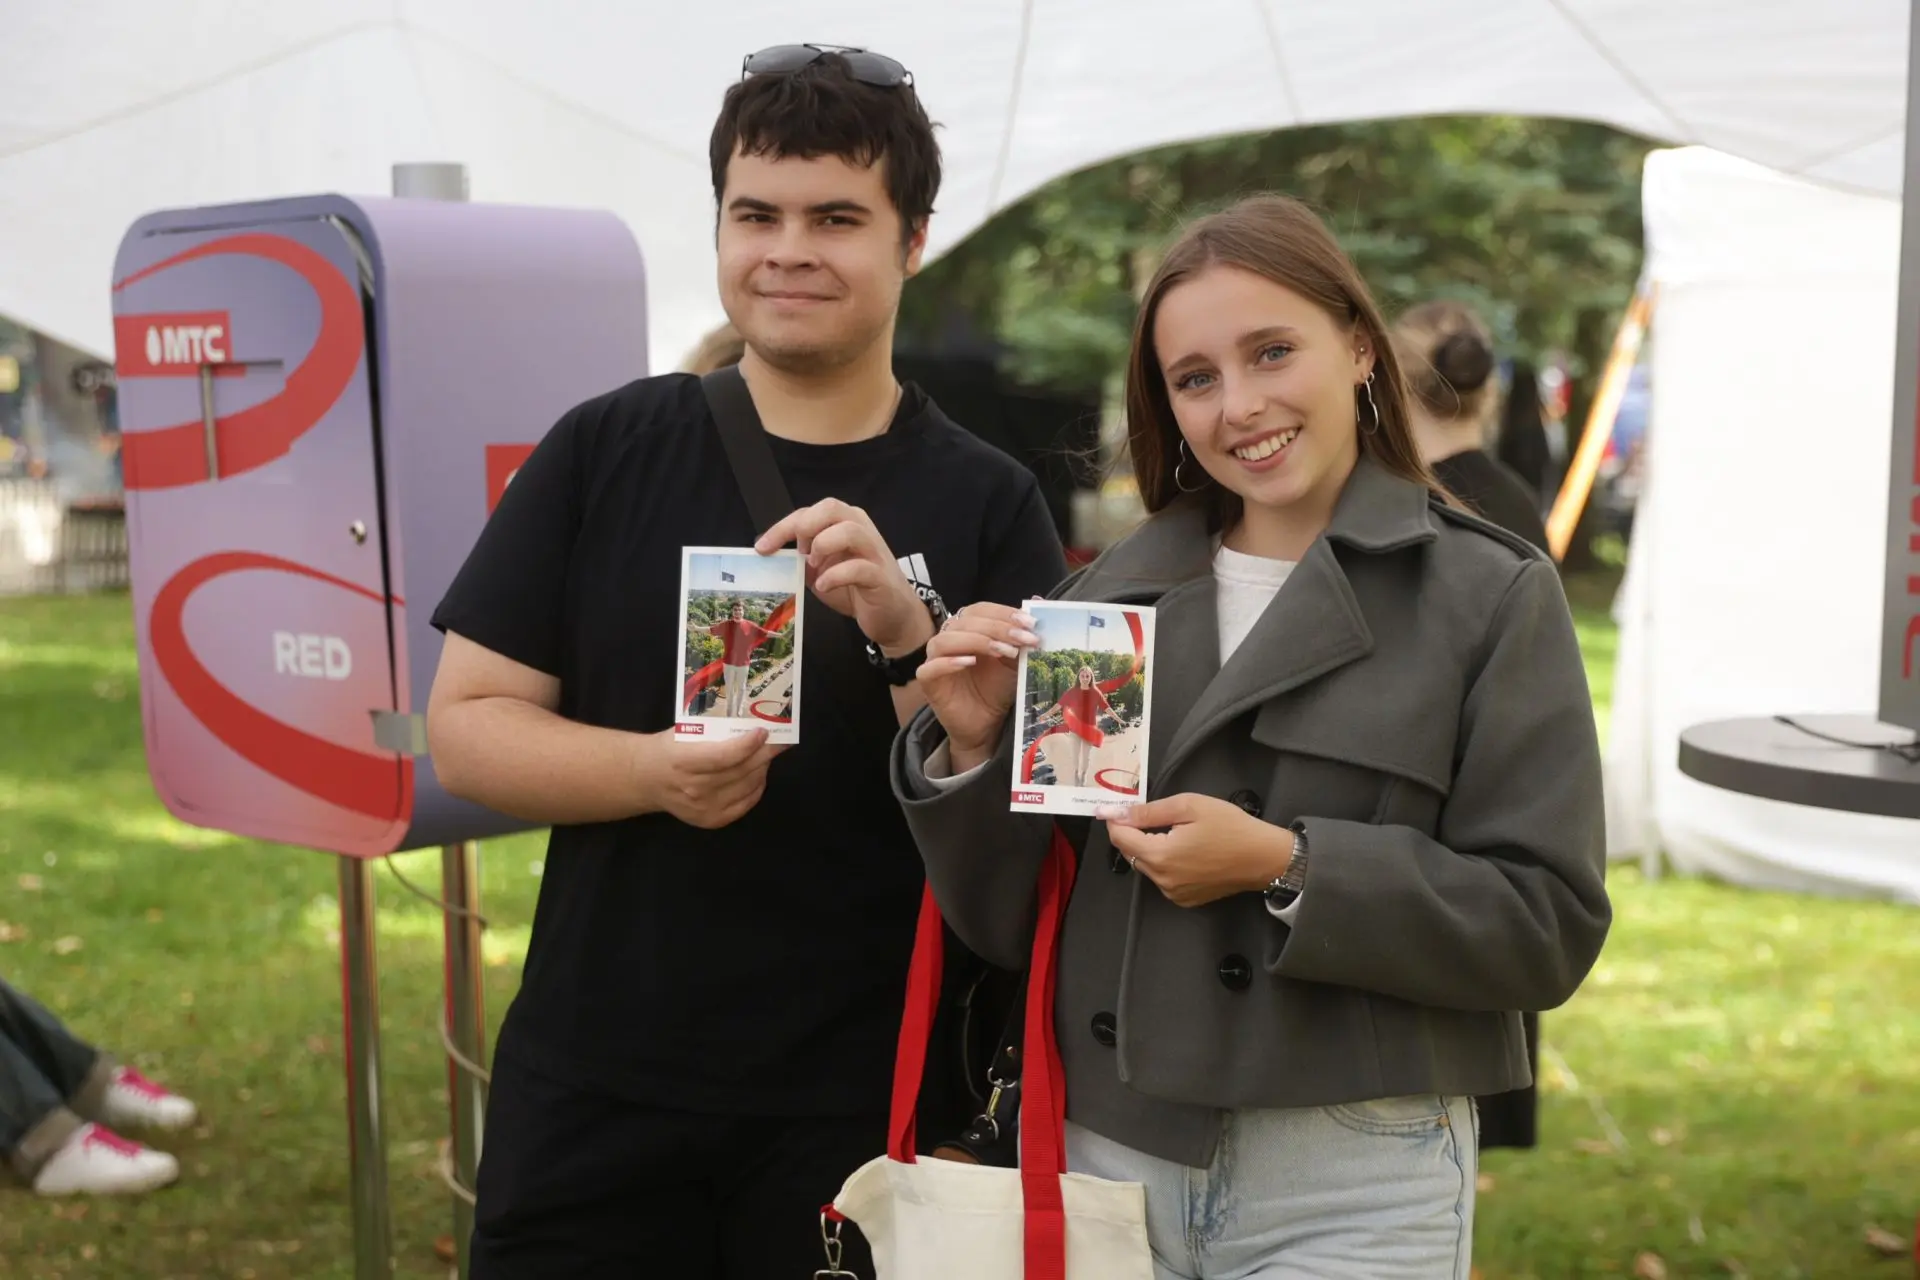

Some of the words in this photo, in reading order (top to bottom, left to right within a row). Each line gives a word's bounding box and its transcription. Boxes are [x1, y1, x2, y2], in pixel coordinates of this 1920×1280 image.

[162, 324, 226, 364] МТС
[272, 630, 353, 680] RED
[1023, 793, 1042, 802] МТС
